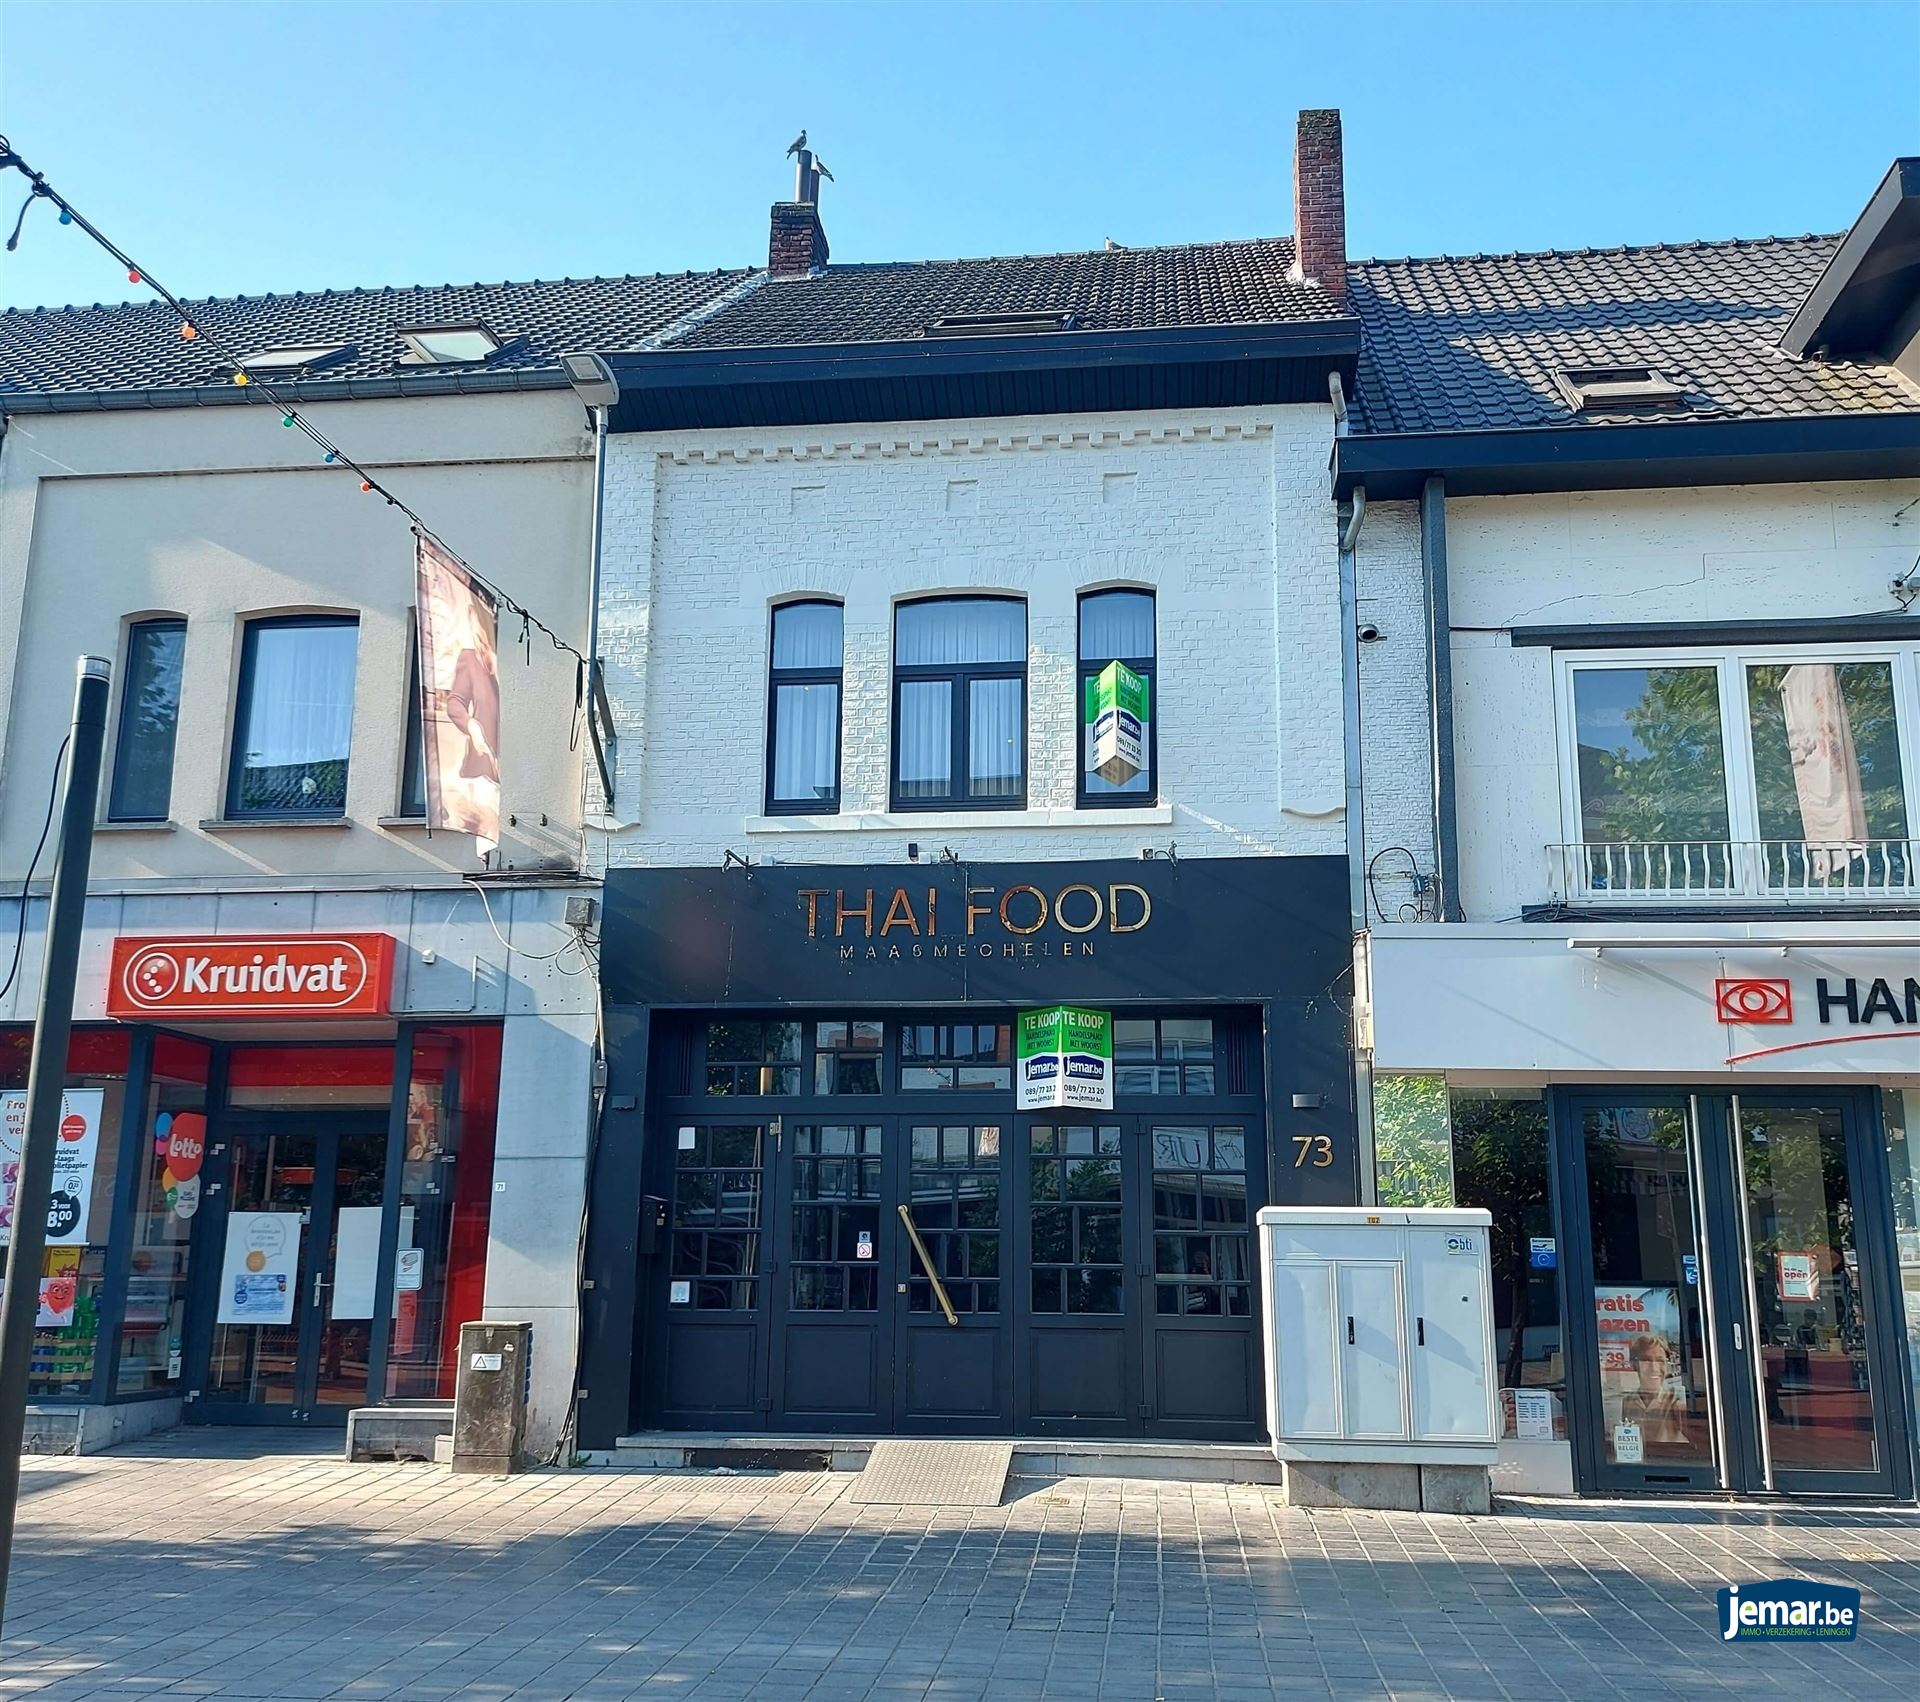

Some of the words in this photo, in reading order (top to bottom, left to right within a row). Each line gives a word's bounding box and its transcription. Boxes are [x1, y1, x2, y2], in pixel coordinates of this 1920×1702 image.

[797, 888, 936, 936] THAI
[967, 884, 1152, 935] FOOD
[183, 954, 348, 993] Kruidvat
[1025, 1016, 1036, 1030] TE
[1037, 1011, 1060, 1028] KOOP
[1063, 1010, 1076, 1025] TE
[1078, 1013, 1104, 1029] KOOP
[1064, 1084, 1087, 1094] 089/77
[1088, 1086, 1095, 1094] 23
[1096, 1087, 1105, 1095] 20
[7, 1100, 26, 1109] Fro
[6, 1114, 19, 1122] en
[57, 1147, 80, 1155] ruidvat
[1291, 1135, 1334, 1168] 73
[54, 1161, 88, 1170] oiletpapier
[51, 1200, 58, 1209] 3
[1784, 1271, 1808, 1280] open
[1596, 1294, 1644, 1312] ratis
[1599, 1319, 1650, 1333] azen
